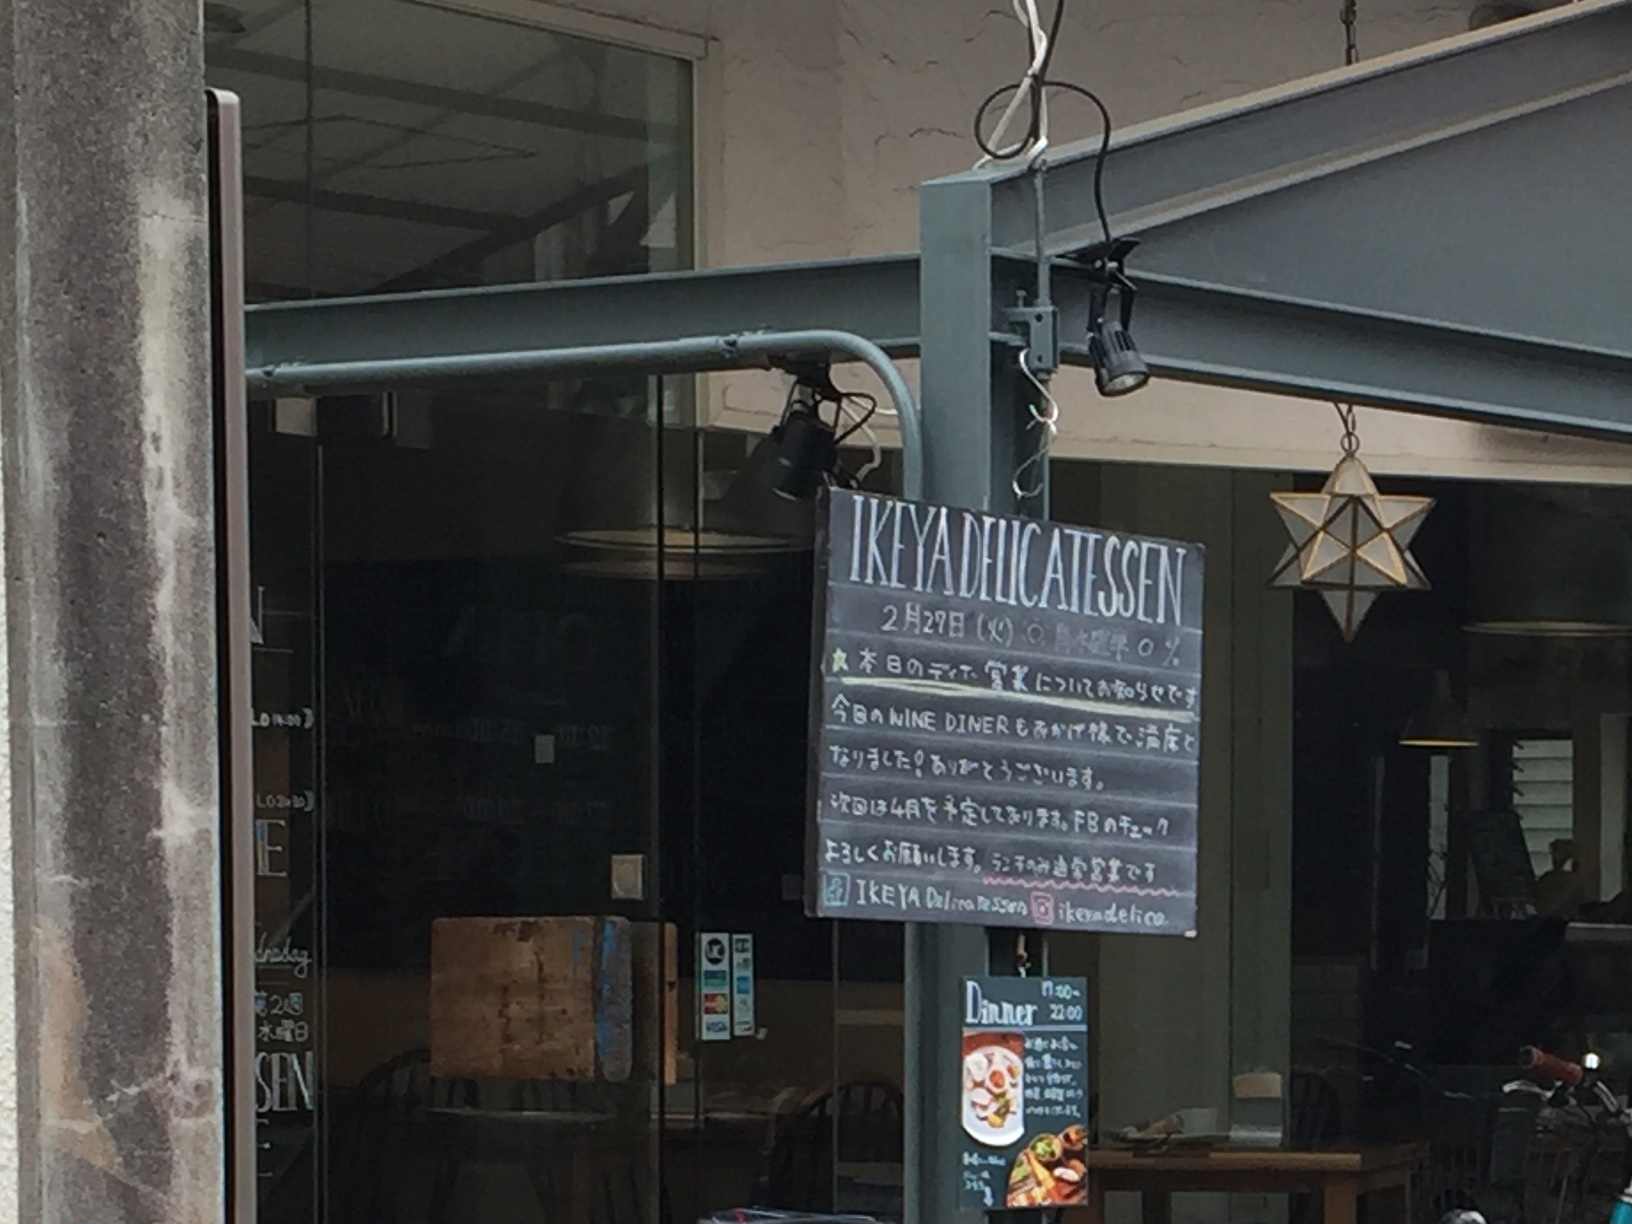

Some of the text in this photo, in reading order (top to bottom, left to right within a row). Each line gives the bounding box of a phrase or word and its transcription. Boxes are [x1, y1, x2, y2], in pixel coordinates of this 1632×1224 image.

[850, 495, 1186, 627] IKEYA DELICATESSEN
[881, 602, 964, 638] 2月27日
[856, 879, 921, 910] IKEYA
[965, 980, 1038, 1026] Dinner
